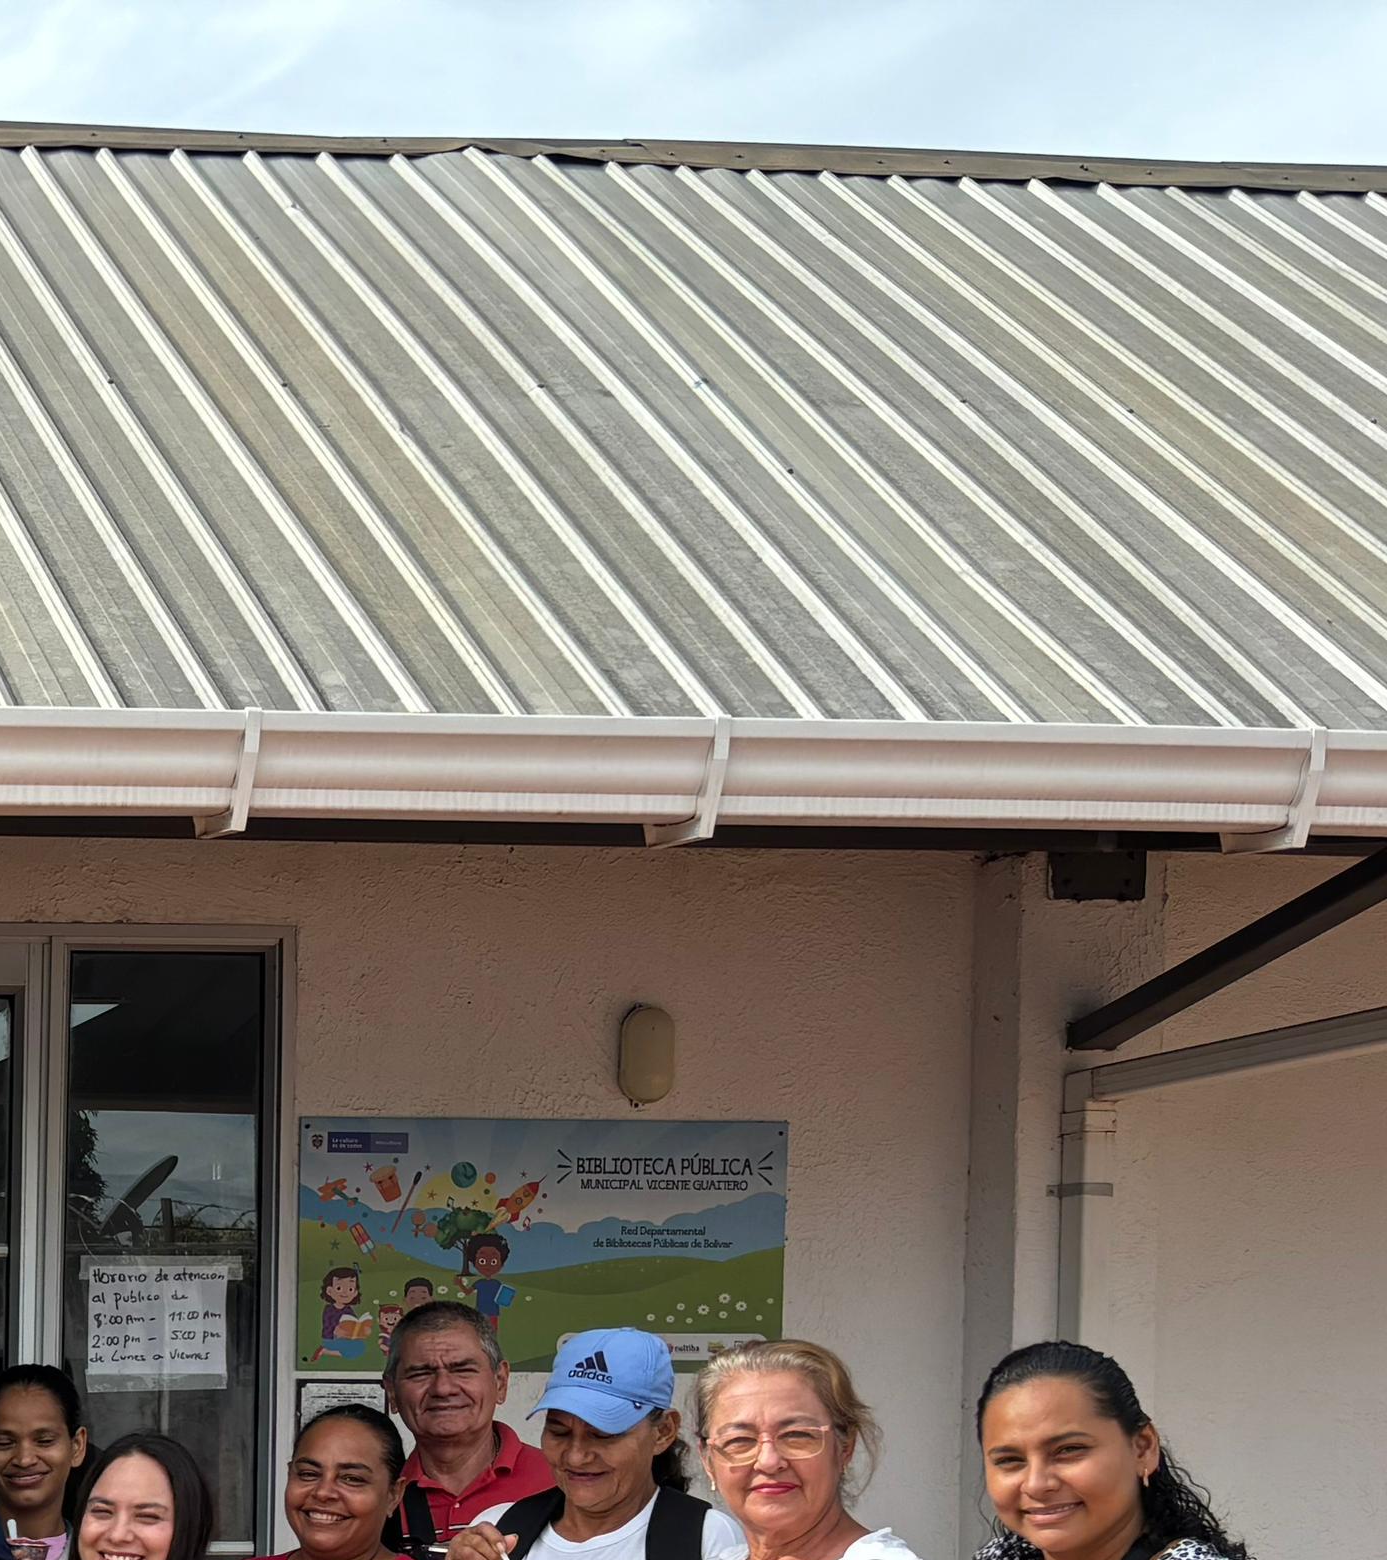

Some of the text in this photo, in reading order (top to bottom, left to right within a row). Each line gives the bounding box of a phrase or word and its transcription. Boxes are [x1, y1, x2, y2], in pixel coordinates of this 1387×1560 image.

[577, 1152, 753, 1176] BIBLIOTECA PÚBLICA
[580, 1179, 643, 1190] MUNICIPAL
[646, 1179, 691, 1191] VICENTE
[621, 1226, 706, 1238] Red Departamental
[593, 1238, 604, 1248] de
[606, 1238, 652, 1248] Bibliotecas
[691, 1239, 702, 1248] de
[92, 1268, 147, 1283] Horario
[154, 1268, 169, 1283] de
[92, 1291, 106, 1304] al
[91, 1335, 119, 1349] 2:00
[90, 1353, 105, 1363] de
